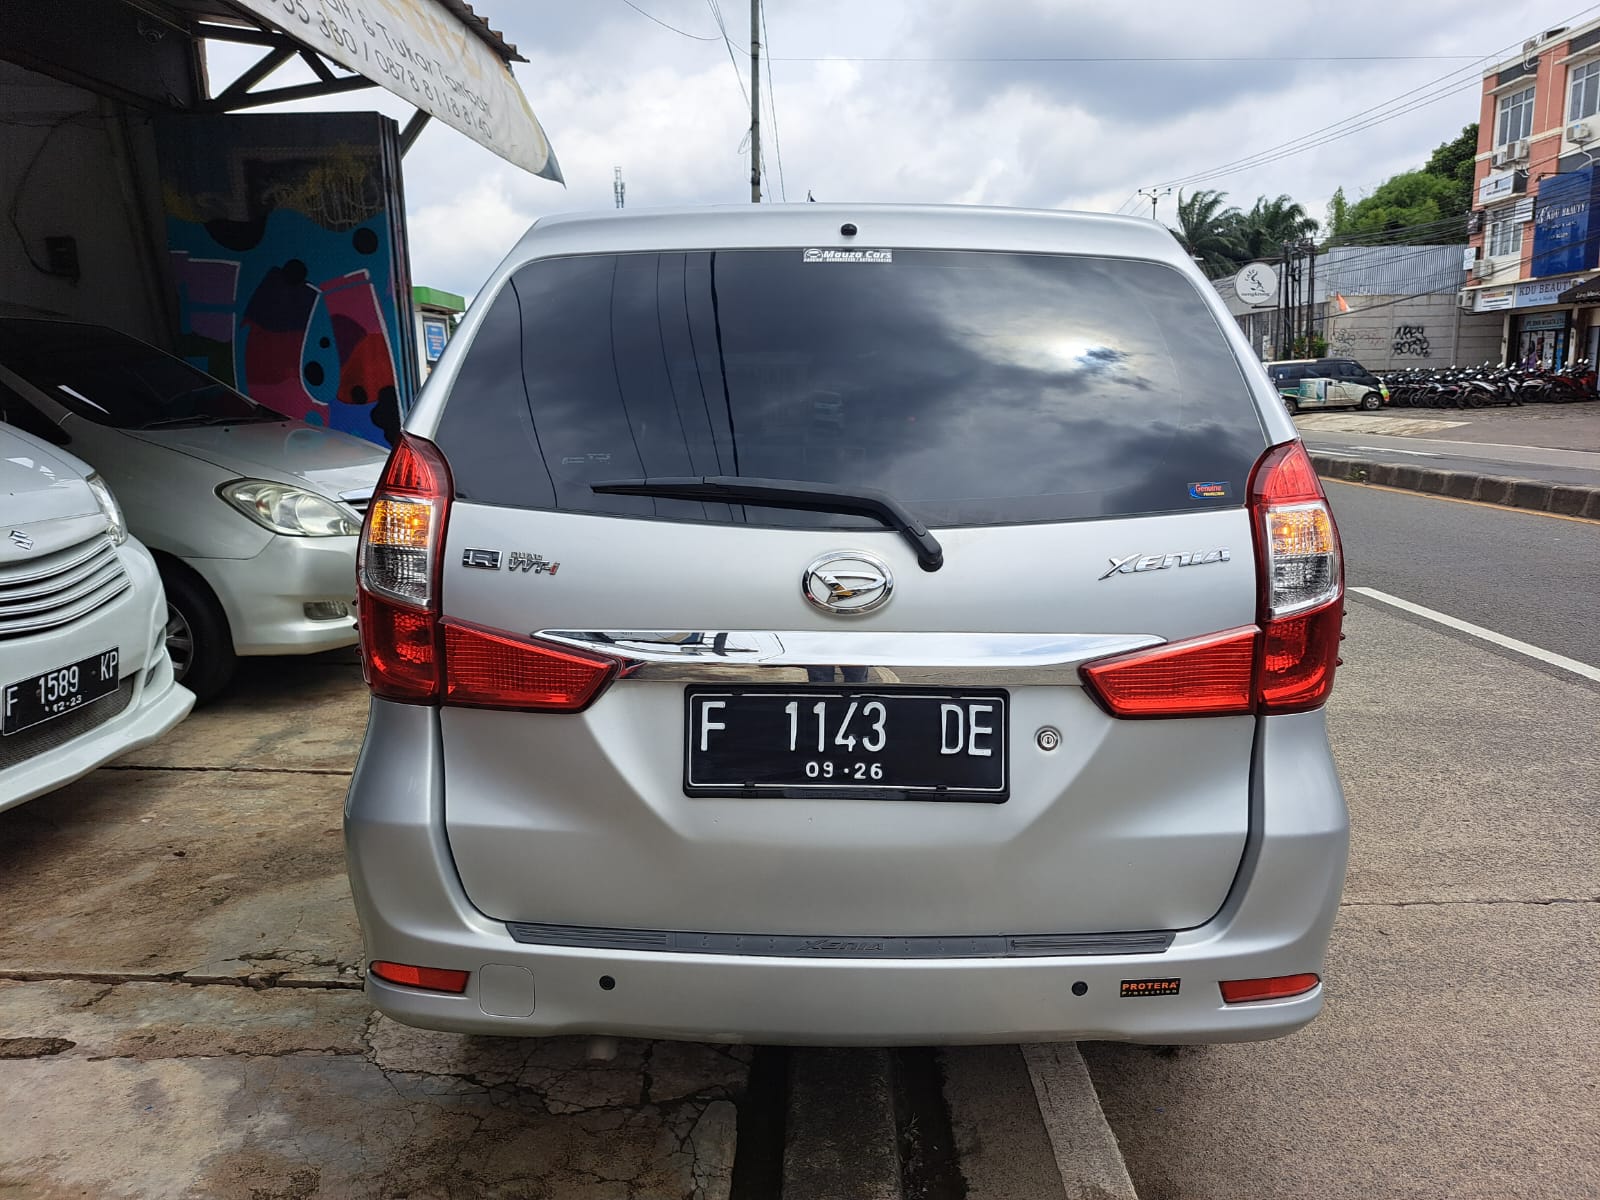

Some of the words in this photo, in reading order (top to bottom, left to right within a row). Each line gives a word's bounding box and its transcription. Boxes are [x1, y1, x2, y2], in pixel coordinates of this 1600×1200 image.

[376, 22, 433, 75] Tukar
[375, 49, 420, 92] 0878
[823, 250, 864, 258] Mauza
[866, 250, 892, 258] Cars
[1518, 286, 1537, 297] KDU
[1195, 484, 1222, 492] Genuine
[7, 686, 18, 717] F
[38, 665, 79, 705] 1589
[100, 651, 118, 681] KP
[700, 701, 726, 752] F
[785, 701, 888, 753] 1143
[940, 703, 994, 758] DE
[1122, 982, 1177, 990] PROTERA
